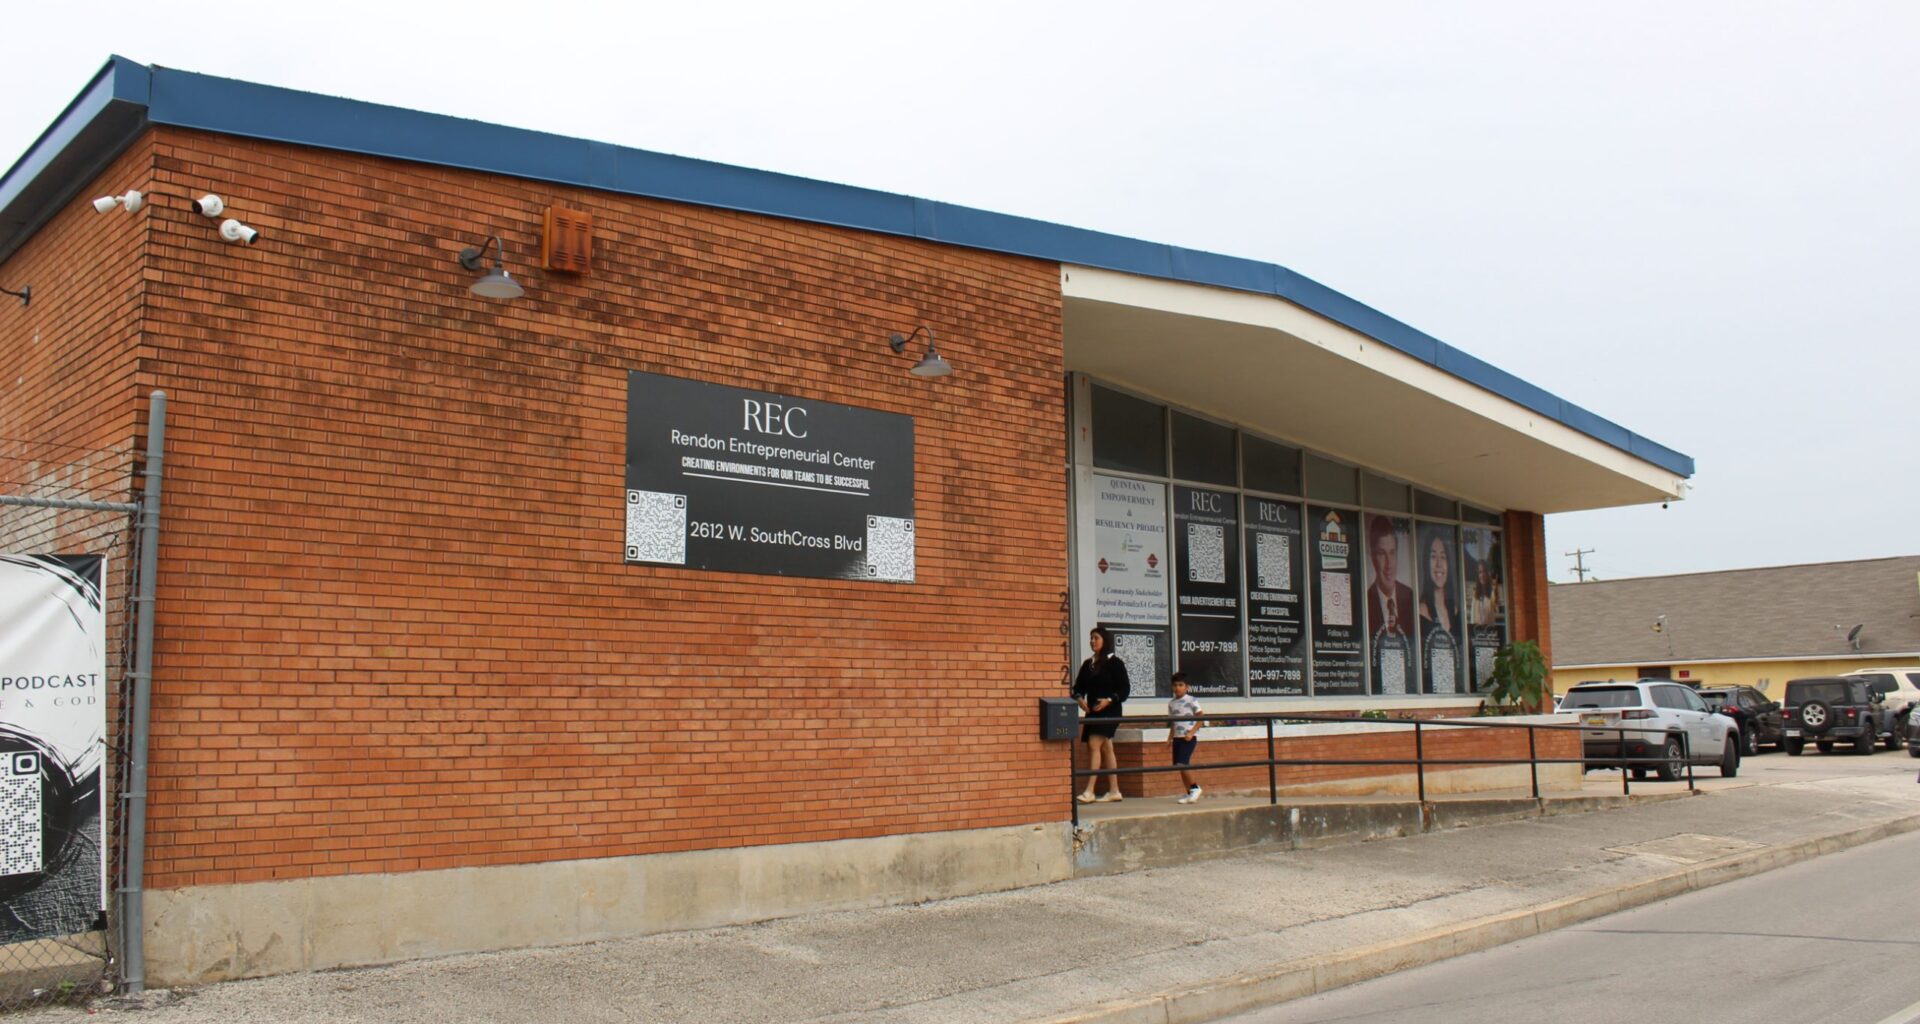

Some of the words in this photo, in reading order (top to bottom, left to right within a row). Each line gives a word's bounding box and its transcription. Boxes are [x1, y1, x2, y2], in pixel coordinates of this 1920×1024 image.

[743, 398, 808, 438] REC
[671, 430, 725, 451] Rendon
[730, 438, 830, 465] Entrepreneurial
[833, 452, 875, 470] Center
[682, 456, 715, 471] CREATING
[716, 462, 766, 477] ENVIRONMENTS
[767, 467, 780, 479] FOR
[780, 469, 793, 481] OUR
[795, 470, 815, 483] TEAMS
[816, 473, 824, 485] TO
[825, 474, 833, 486] BE
[834, 475, 870, 490] SUCCESSFUL
[1110, 480, 1146, 491] QUINTANA
[1101, 491, 1155, 506] EMPOWERMENT
[1191, 491, 1222, 513] REC
[1260, 502, 1288, 523] REC
[1095, 519, 1134, 530] RESILIENCY
[1137, 523, 1164, 533] PROJECT
[690, 522, 723, 539] 2612
[728, 526, 747, 541] W.
[750, 528, 830, 549] SouthCross
[834, 535, 862, 552] Blvd
[1320, 543, 1348, 555] COLLEGE
[1106, 586, 1134, 597] Community
[1225, 598, 1237, 608] HERE
[1182, 640, 1238, 652] 210-997-7898
[1, 673, 98, 691] PODCAST
[1250, 670, 1301, 680] 210-997-7898
[53, 695, 97, 707] GOD
